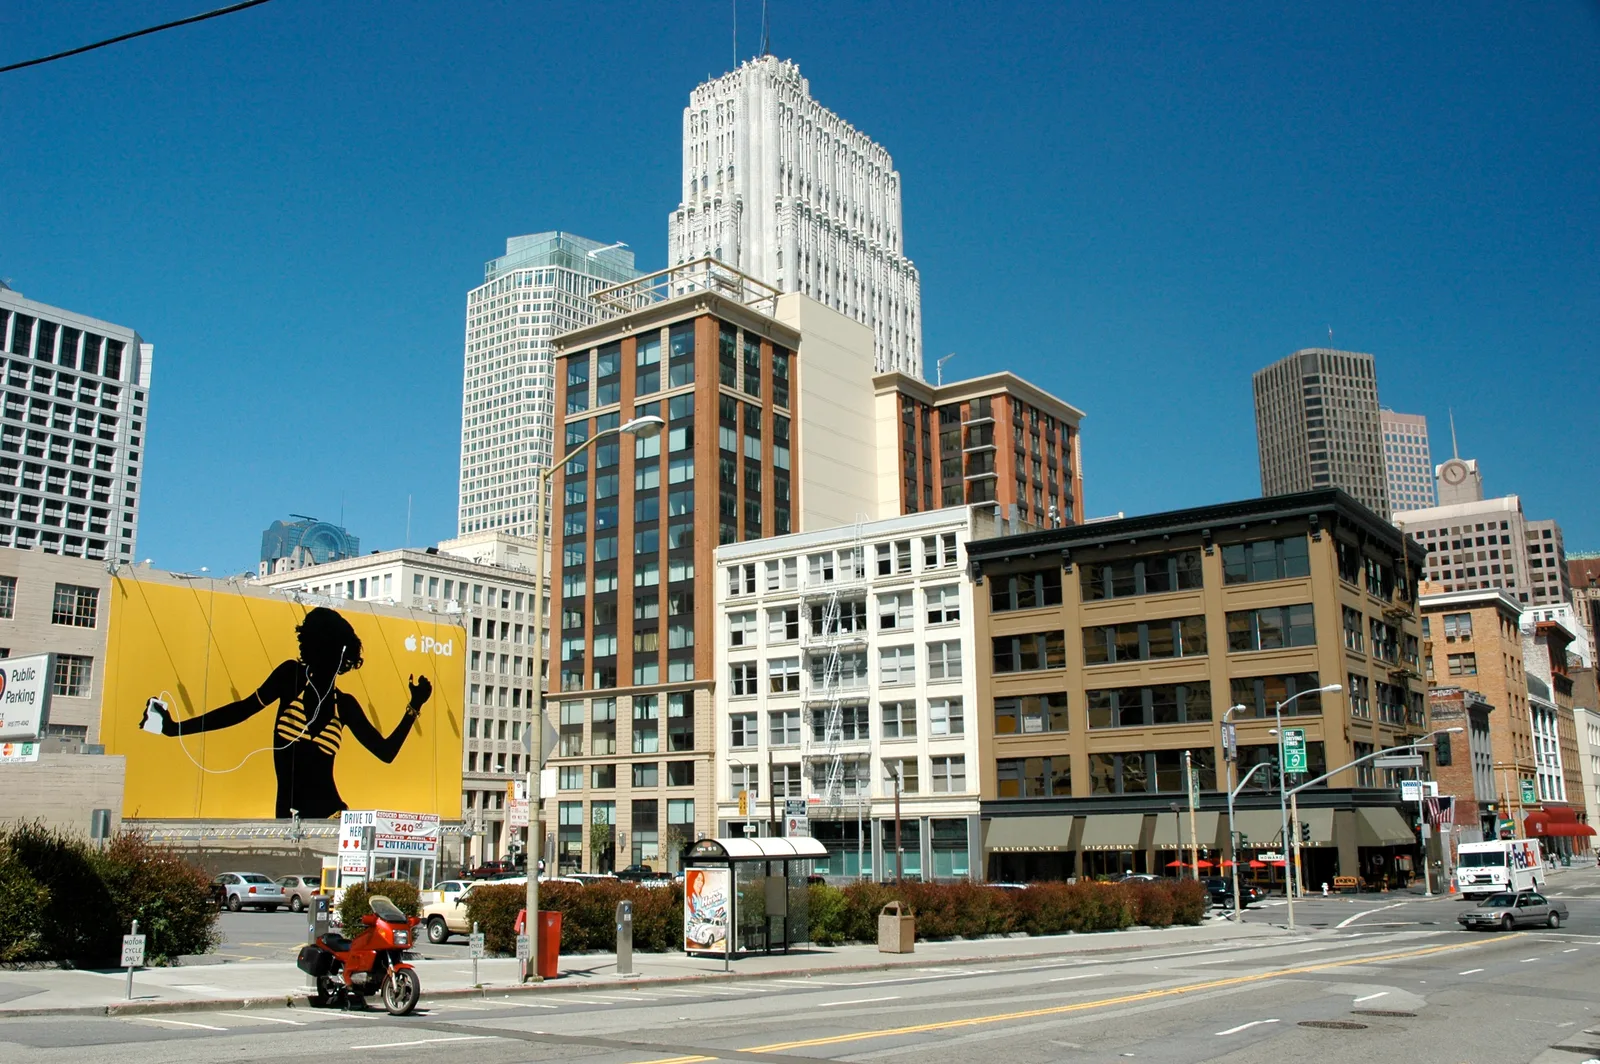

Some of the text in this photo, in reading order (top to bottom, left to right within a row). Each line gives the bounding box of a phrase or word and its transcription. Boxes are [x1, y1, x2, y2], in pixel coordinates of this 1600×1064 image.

[421, 635, 453, 657] iPod
[11, 667, 36, 682] Public
[5, 689, 35, 705] Parking
[344, 813, 373, 824] DRIVE TO
[377, 811, 398, 819] REDUCED
[349, 826, 363, 837] HER
[385, 840, 427, 851] ENTRANCE
[1511, 842, 1537, 870] FedEx
